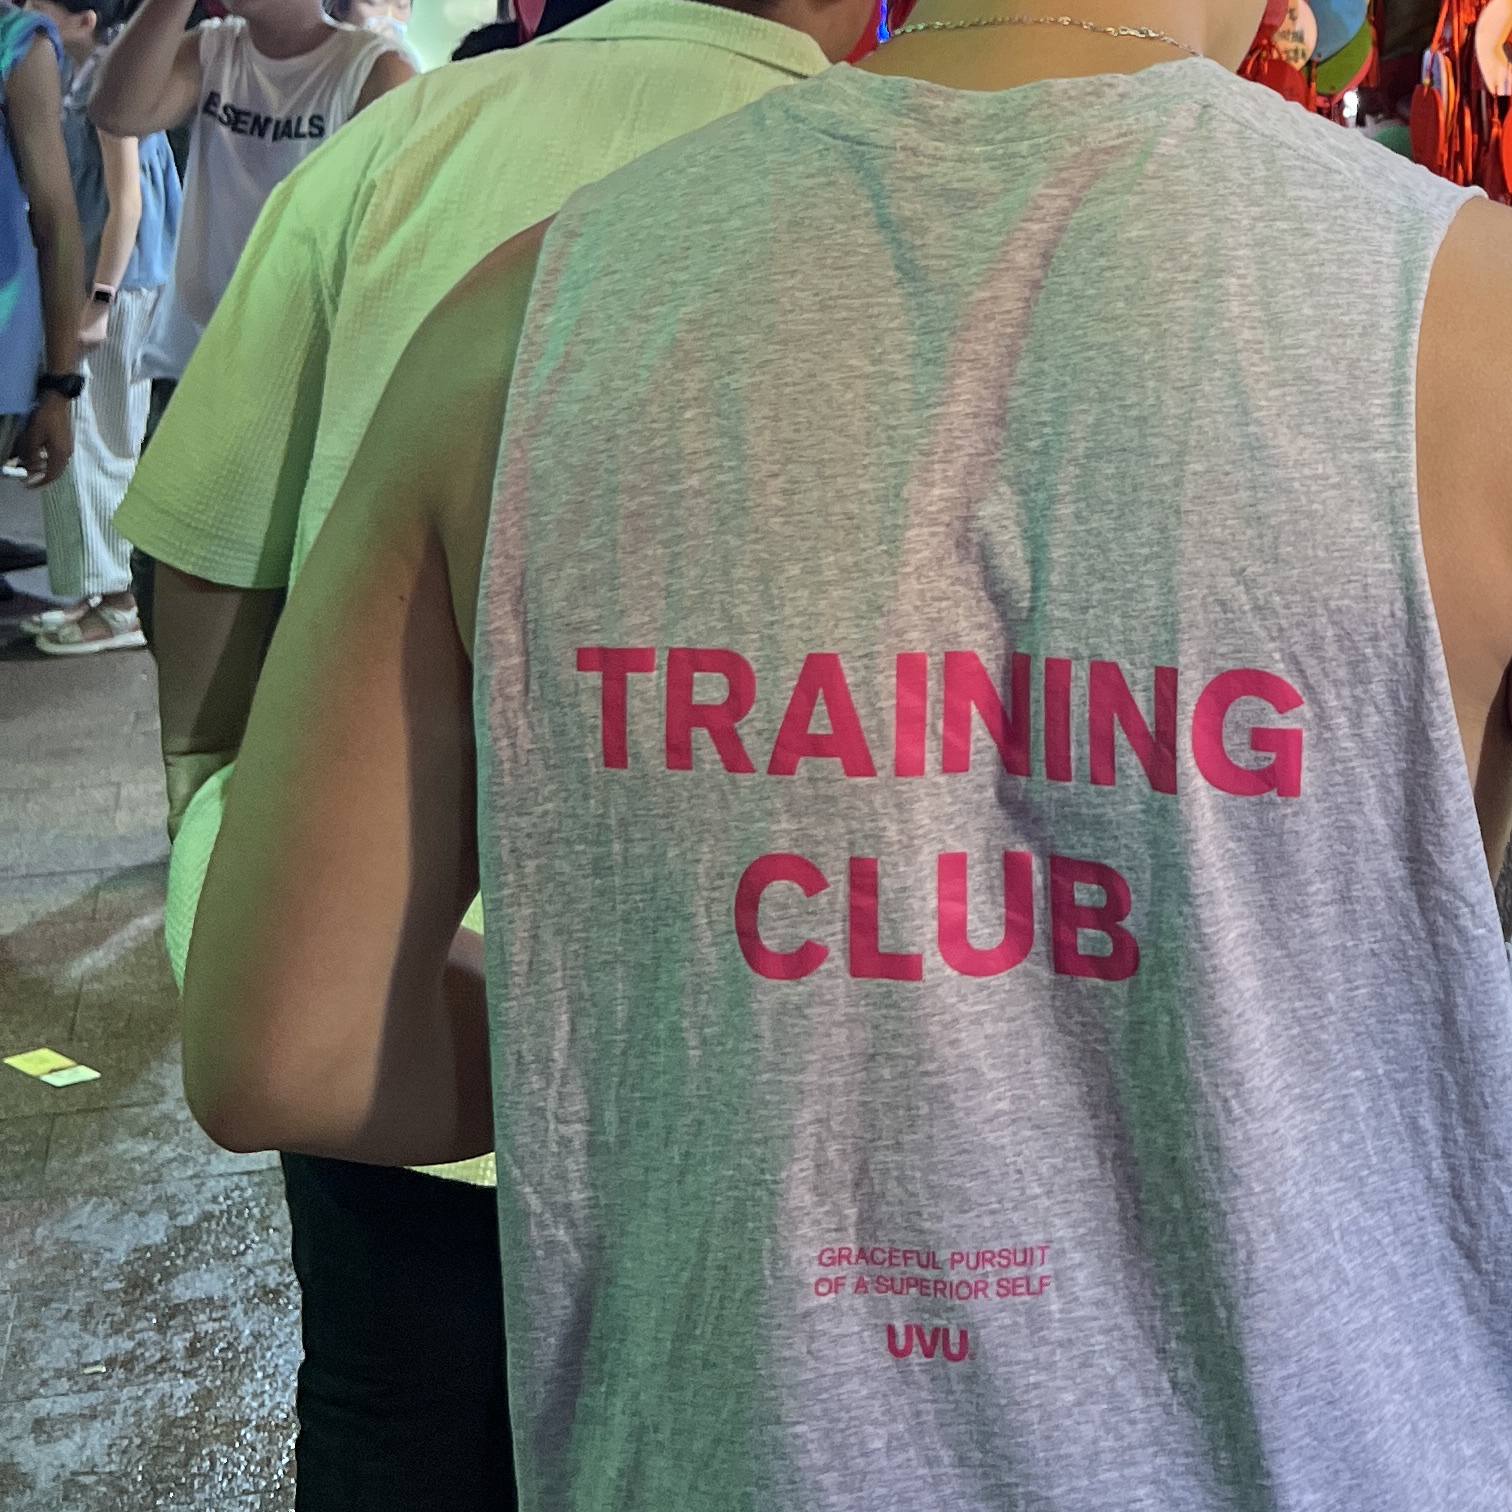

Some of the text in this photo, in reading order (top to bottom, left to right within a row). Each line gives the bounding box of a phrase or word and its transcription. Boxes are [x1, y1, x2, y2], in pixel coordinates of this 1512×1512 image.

[575, 645, 1306, 799] TRAINING
[733, 850, 1142, 982] CLUB
[813, 1275, 1051, 1301] OF A SUPERIOR SELF
[817, 1244, 1050, 1271] GRACEFUL PURSUIT
